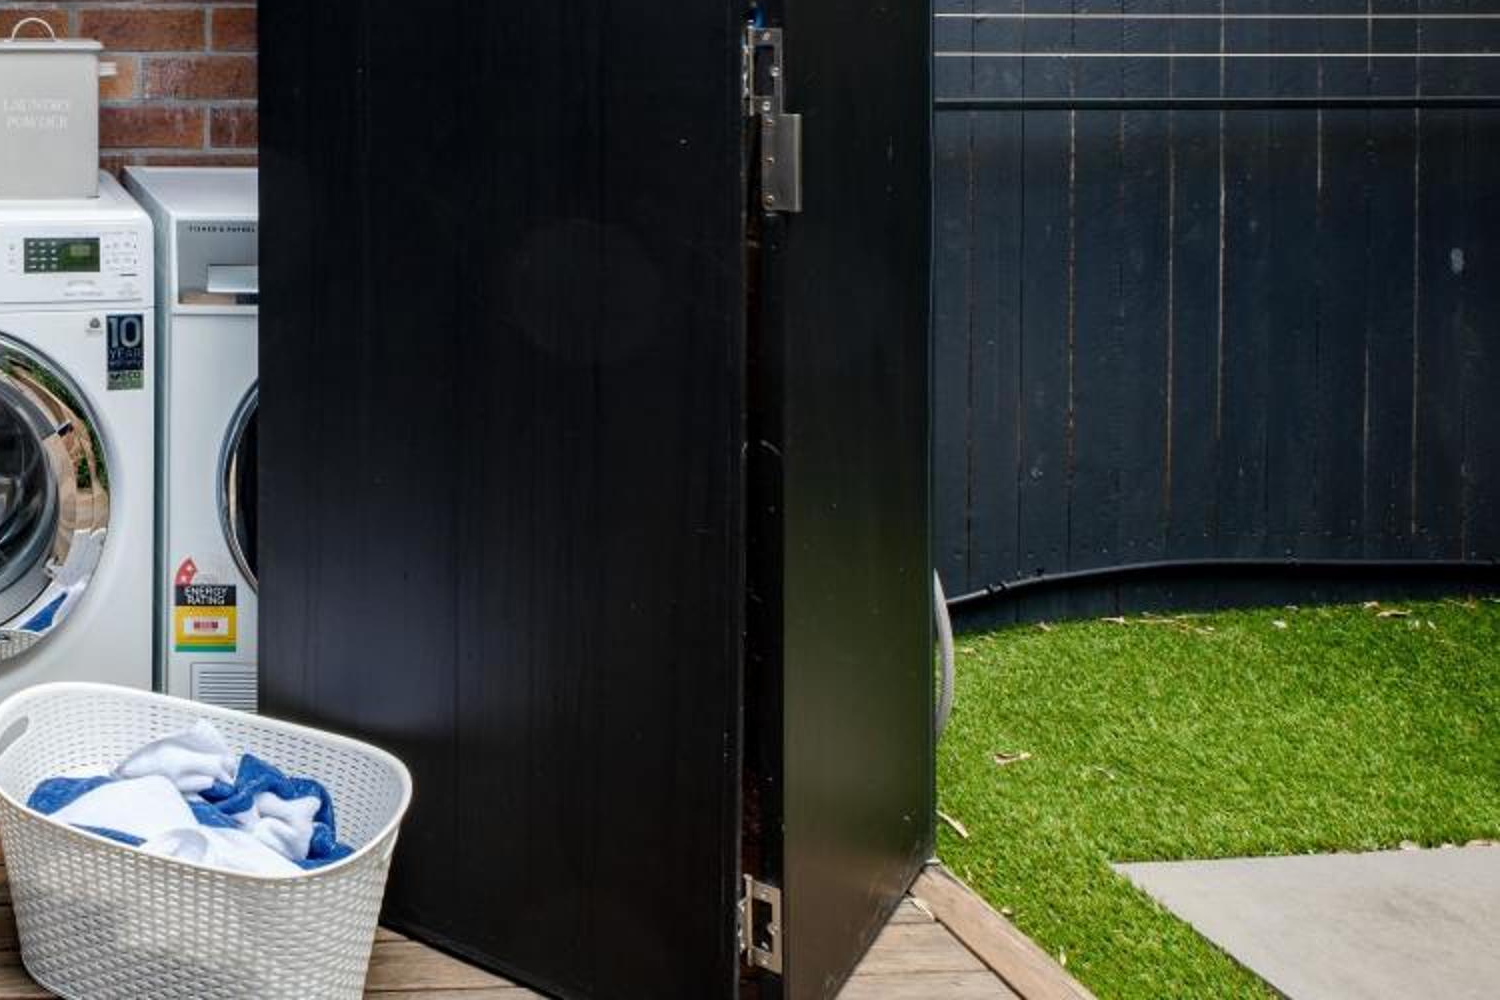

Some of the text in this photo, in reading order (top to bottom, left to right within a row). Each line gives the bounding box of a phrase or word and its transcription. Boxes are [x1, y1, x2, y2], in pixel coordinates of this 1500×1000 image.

[108, 316, 141, 348] 10
[184, 586, 228, 597] ENERGY
[187, 596, 225, 605] RATING
